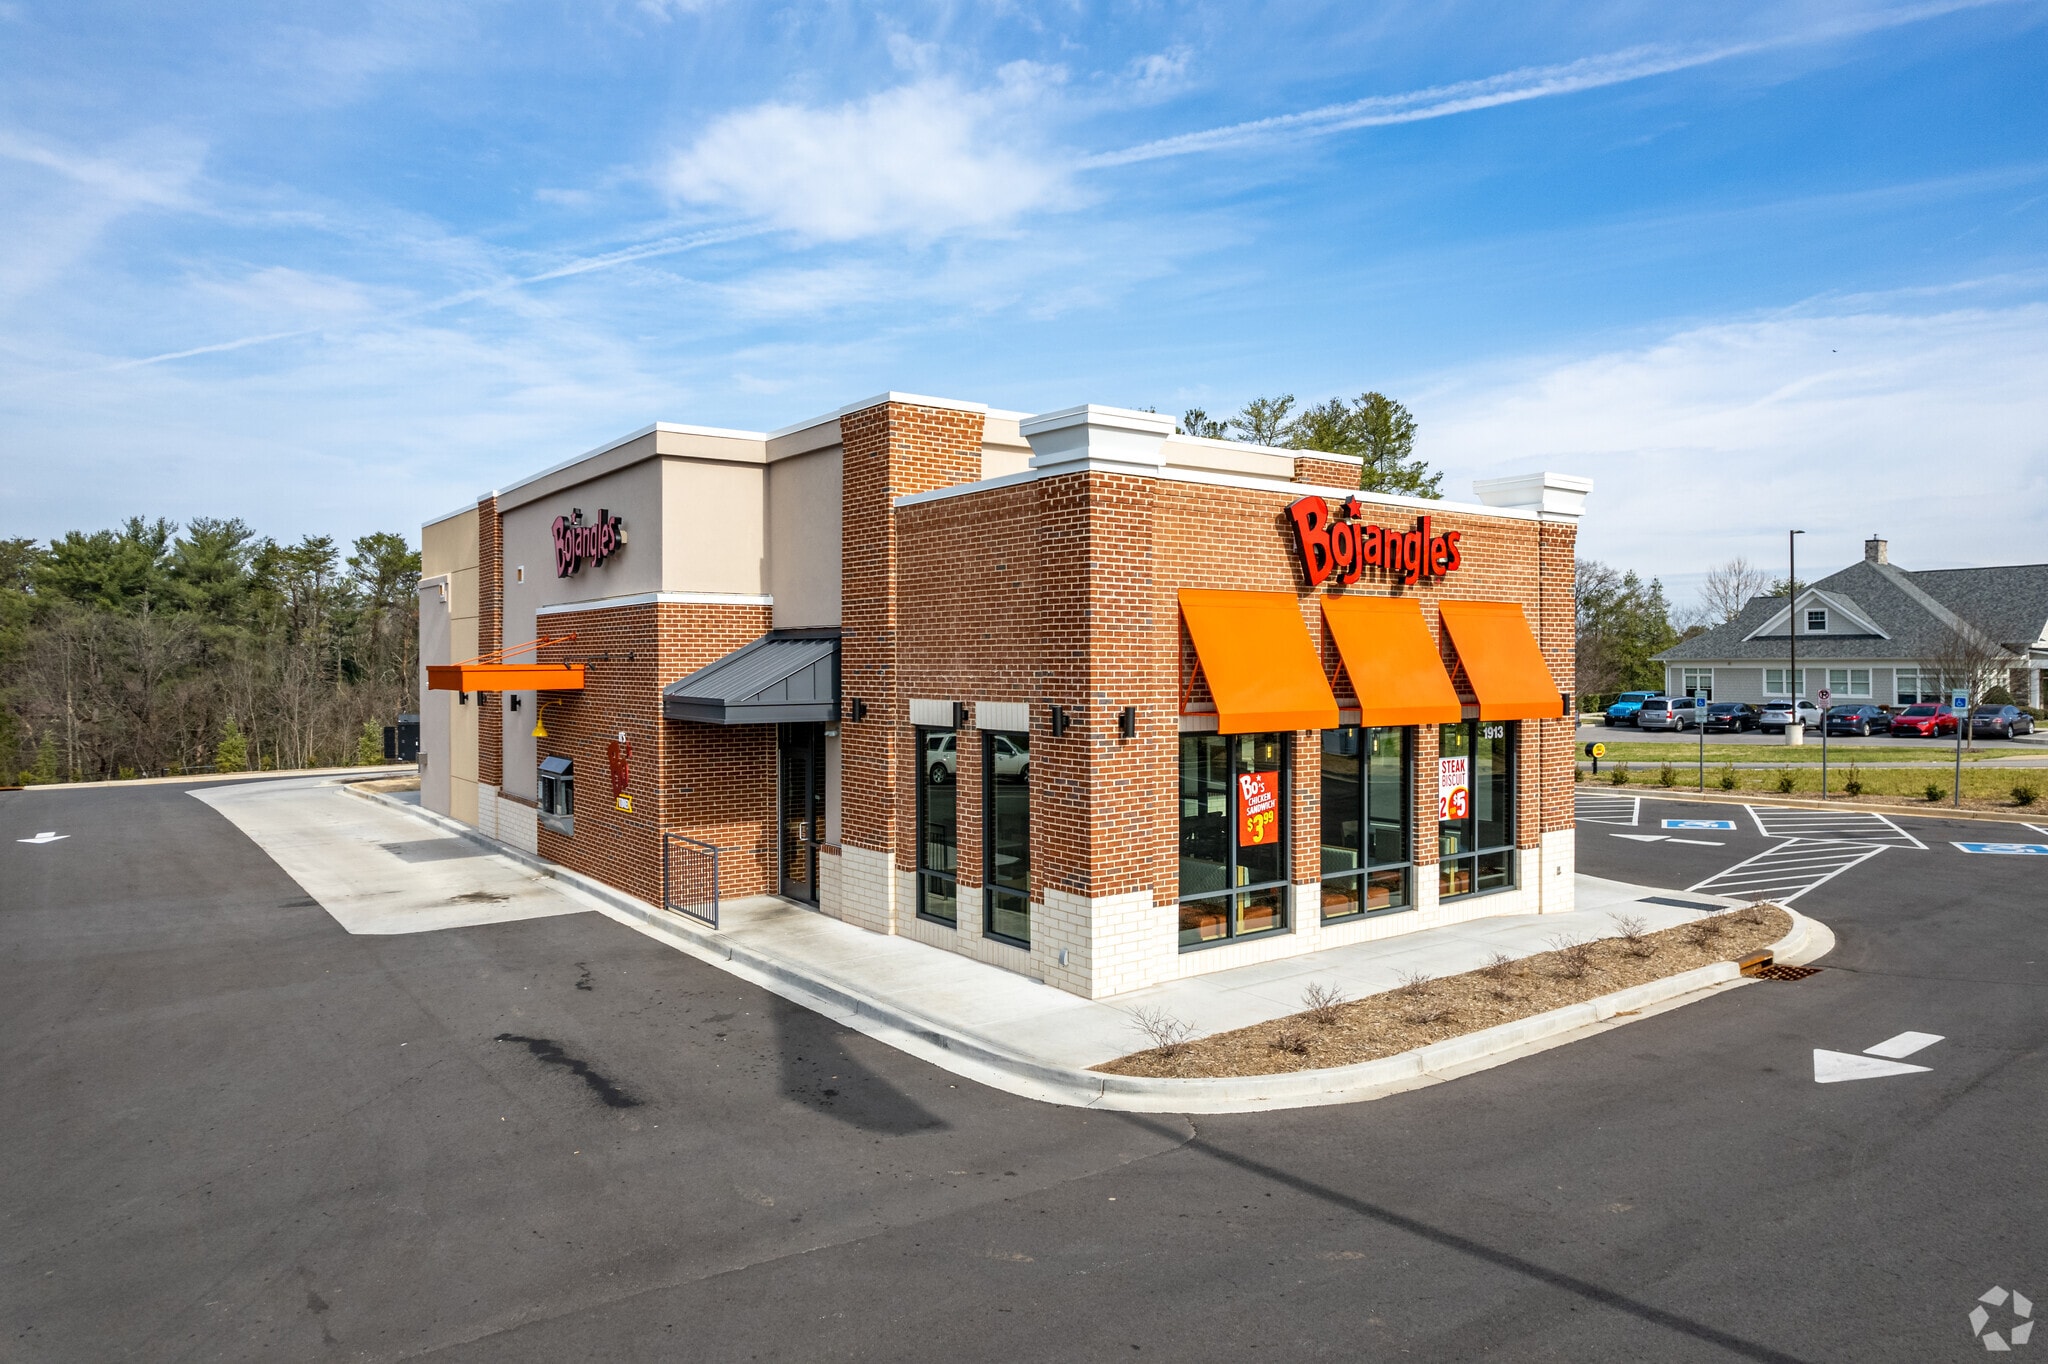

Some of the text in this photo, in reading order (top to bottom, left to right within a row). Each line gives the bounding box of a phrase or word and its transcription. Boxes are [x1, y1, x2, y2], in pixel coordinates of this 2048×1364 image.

[552, 508, 620, 578] Bojangles
[1286, 495, 1461, 586] Bojangles
[1483, 726, 1504, 739] 1913
[1441, 759, 1465, 774] STEAK
[1441, 773, 1465, 787] BISCUIT
[1248, 792, 1272, 807] CHICKEN
[1440, 790, 1466, 818] 2 $5
[1246, 800, 1276, 816] SANDWICH
